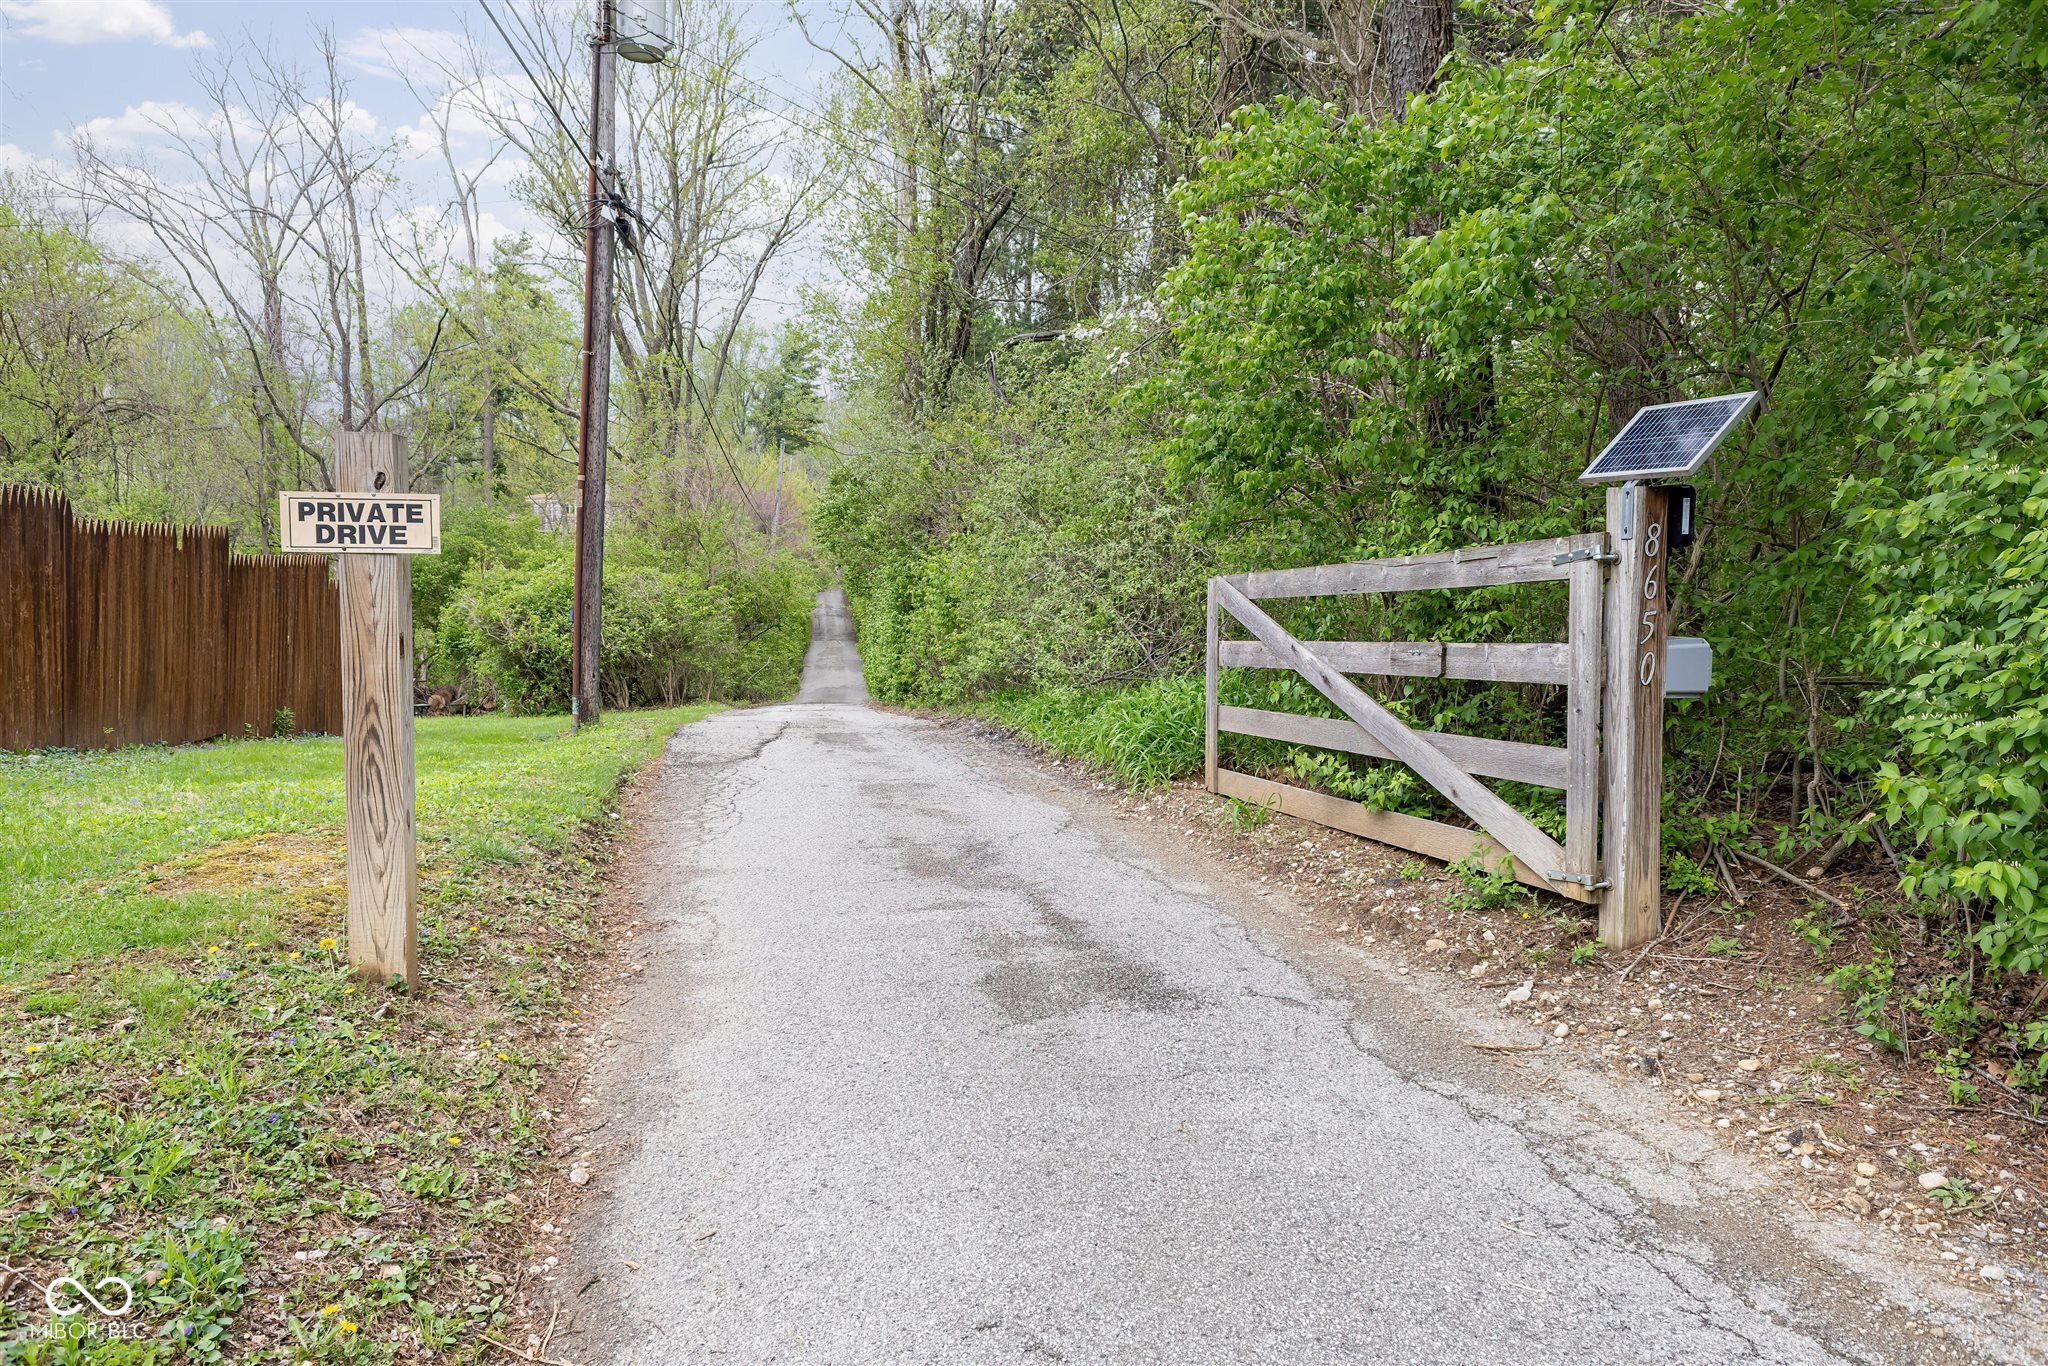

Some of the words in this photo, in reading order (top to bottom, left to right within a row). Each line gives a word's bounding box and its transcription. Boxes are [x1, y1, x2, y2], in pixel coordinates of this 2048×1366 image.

[298, 502, 424, 523] PRIVATE
[315, 524, 408, 544] DRIVE
[1639, 523, 1661, 686] 8650
